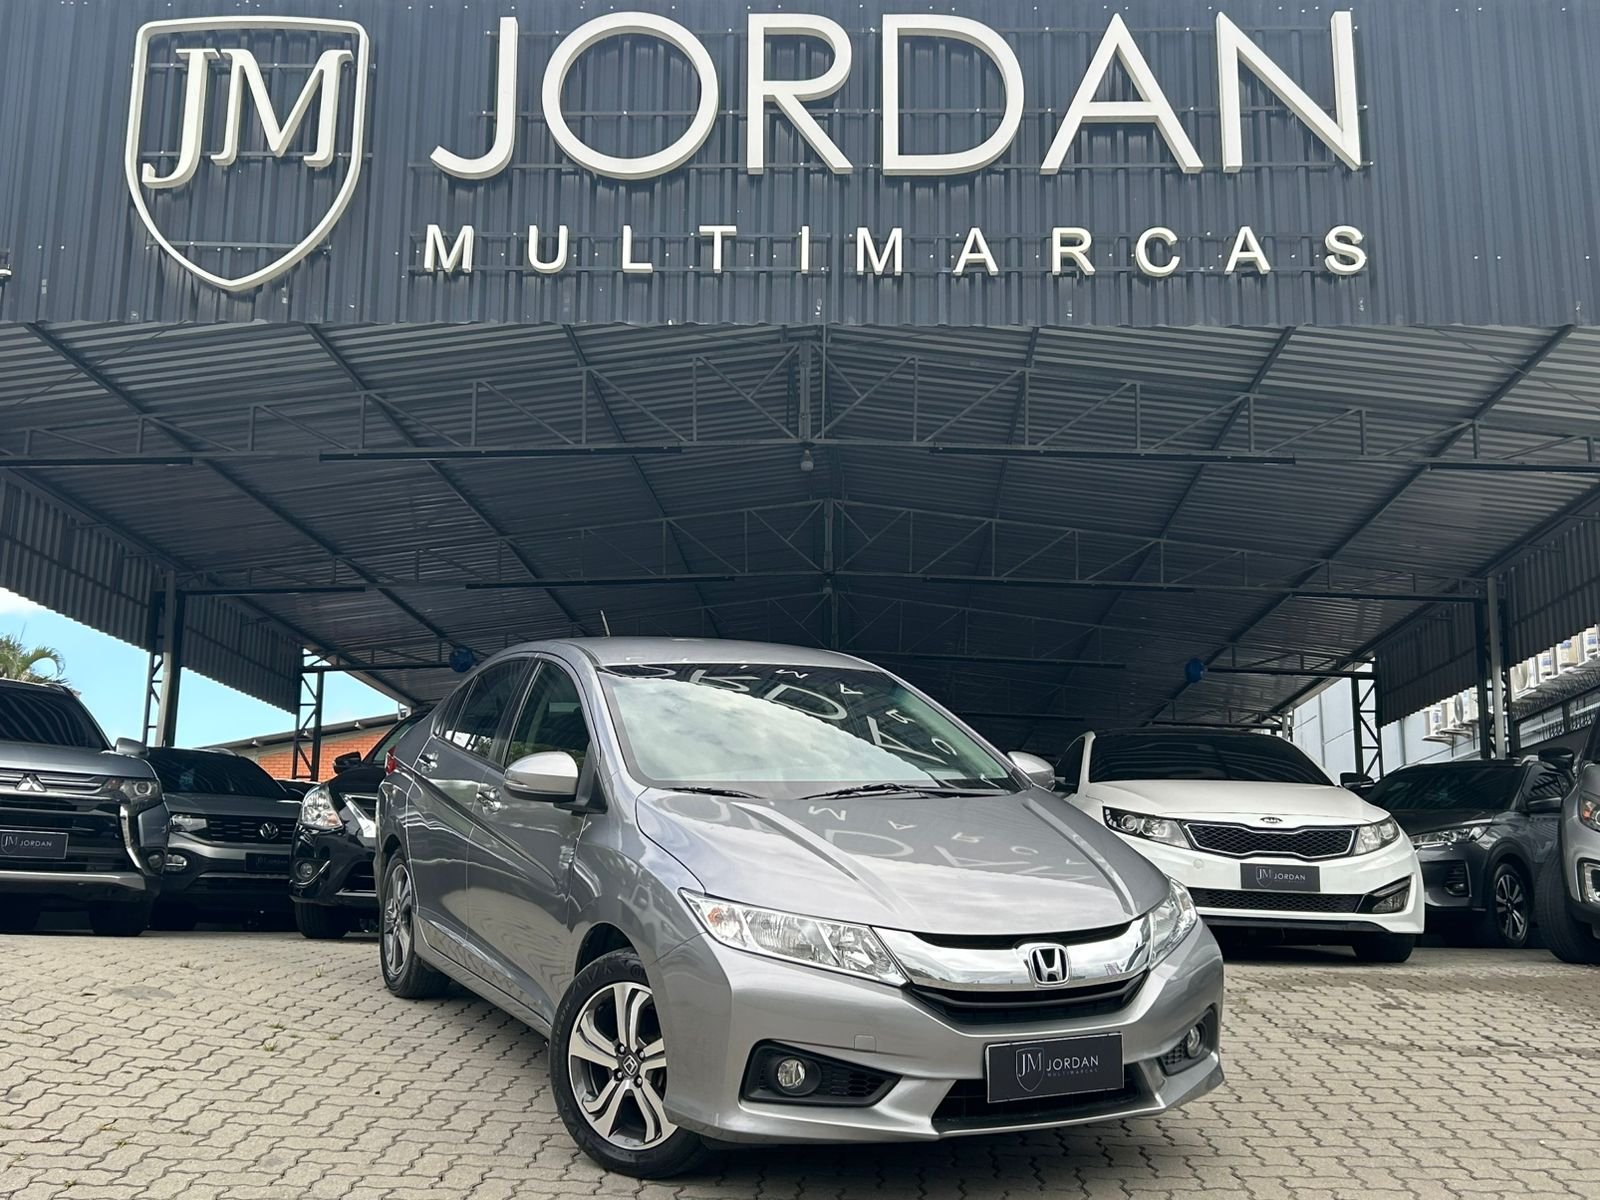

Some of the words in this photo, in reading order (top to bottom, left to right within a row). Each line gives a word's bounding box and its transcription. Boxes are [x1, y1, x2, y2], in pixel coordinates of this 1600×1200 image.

[141, 47, 355, 188] JM
[430, 11, 1362, 181] JORDAN
[423, 223, 1367, 275] MULTIMARCAS
[1274, 873, 1306, 881] JORDAN
[1018, 1052, 1042, 1077] JM
[1046, 1055, 1099, 1072] JORDAN
